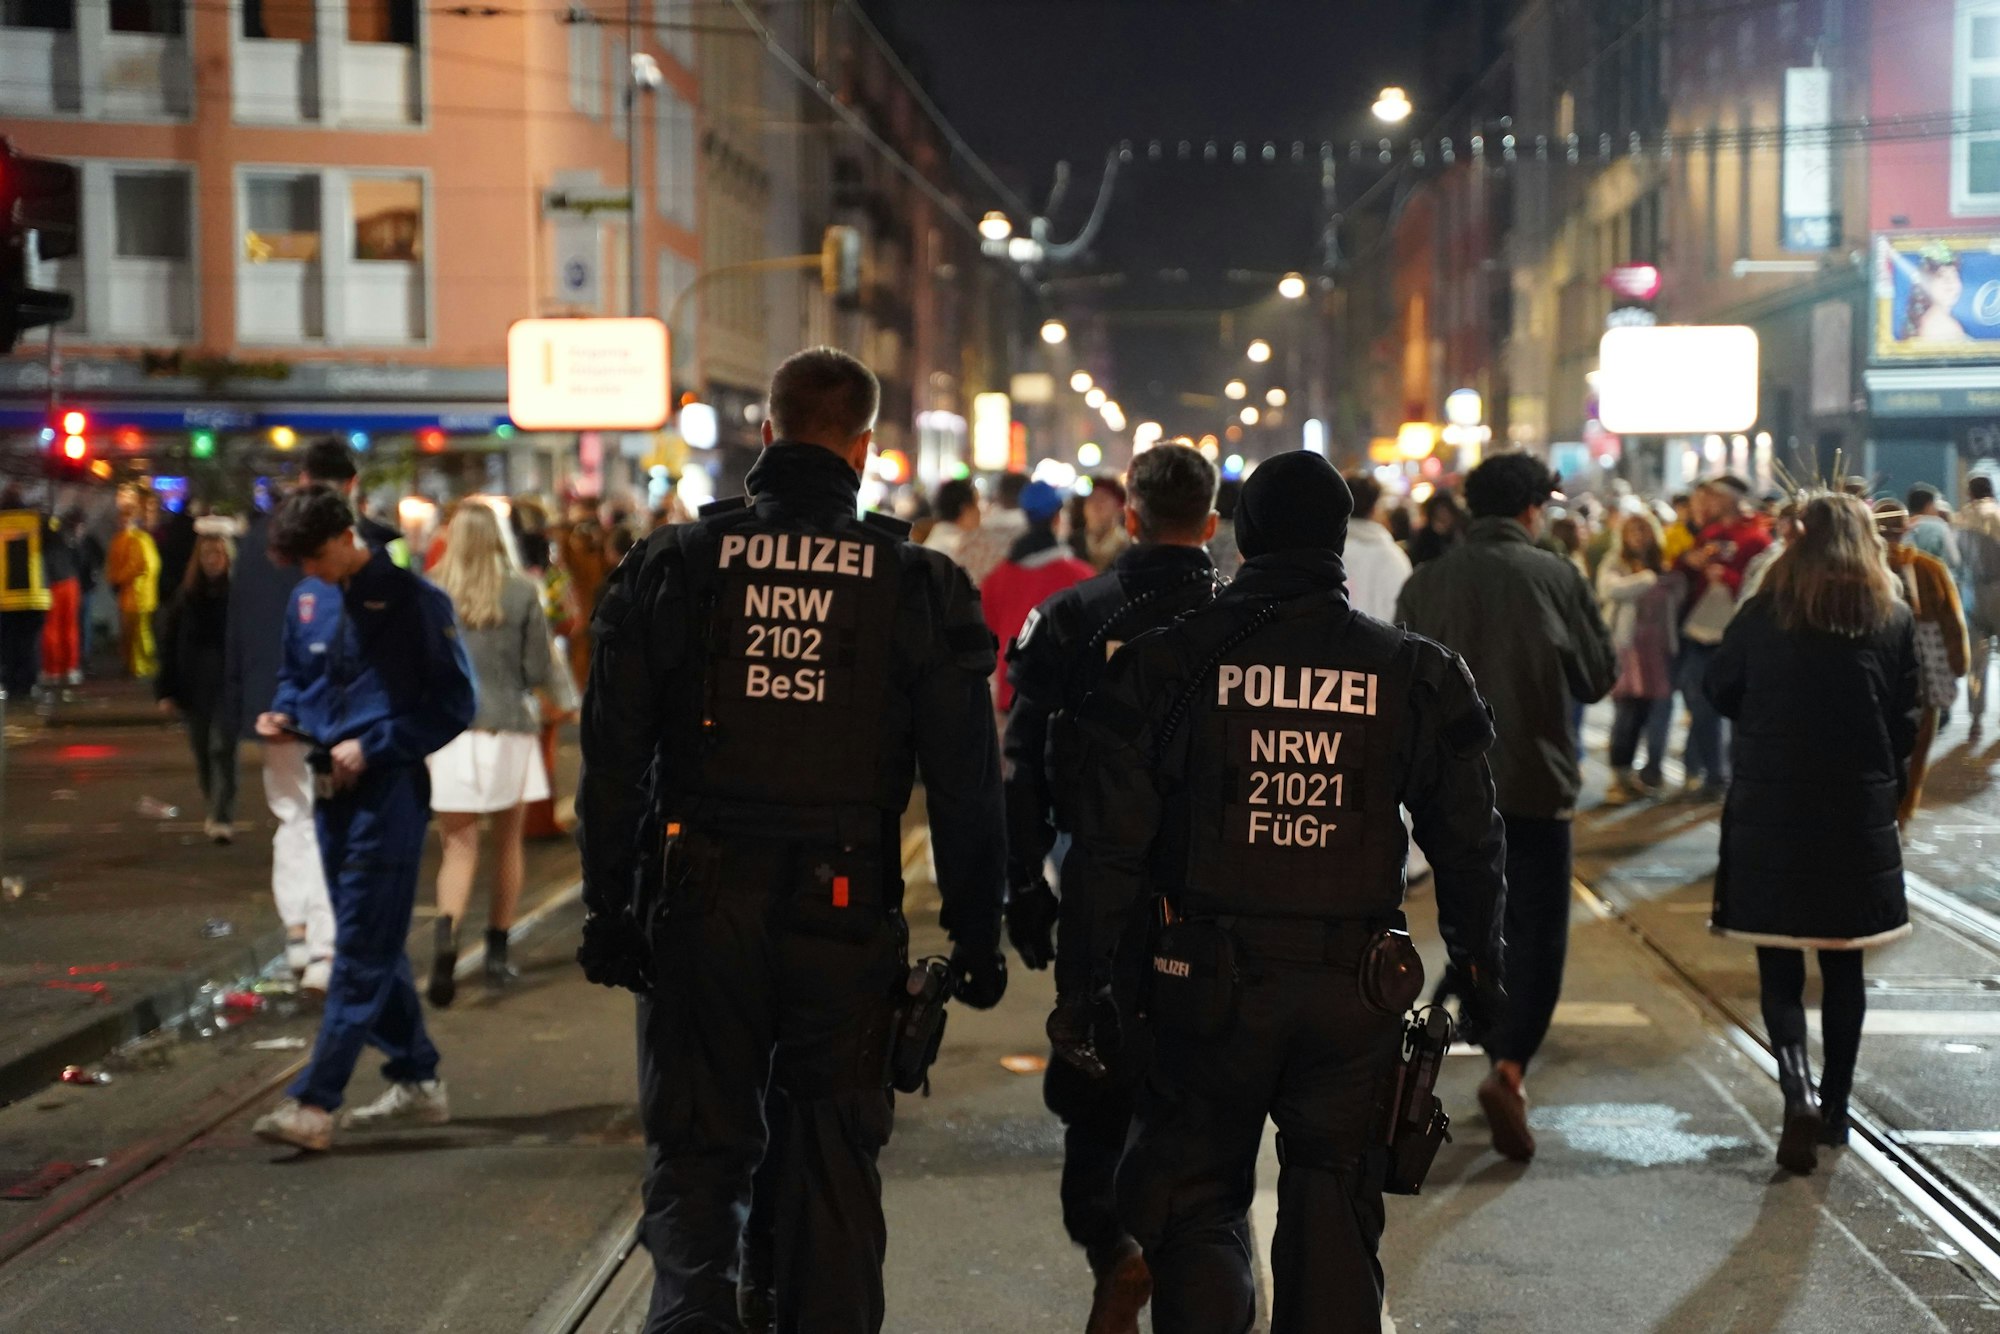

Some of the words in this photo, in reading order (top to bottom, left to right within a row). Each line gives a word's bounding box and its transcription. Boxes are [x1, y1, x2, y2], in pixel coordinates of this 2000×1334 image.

[718, 533, 875, 579] POLIZEI
[744, 584, 833, 622] NRW
[745, 624, 822, 661] 2102
[746, 664, 826, 702] BeSi
[1217, 664, 1378, 716] POLIZEI
[1250, 729, 1342, 764] NRW
[1248, 770, 1343, 806] 21021
[1248, 810, 1337, 848] FüGr
[1153, 956, 1190, 978] POLIZEI
